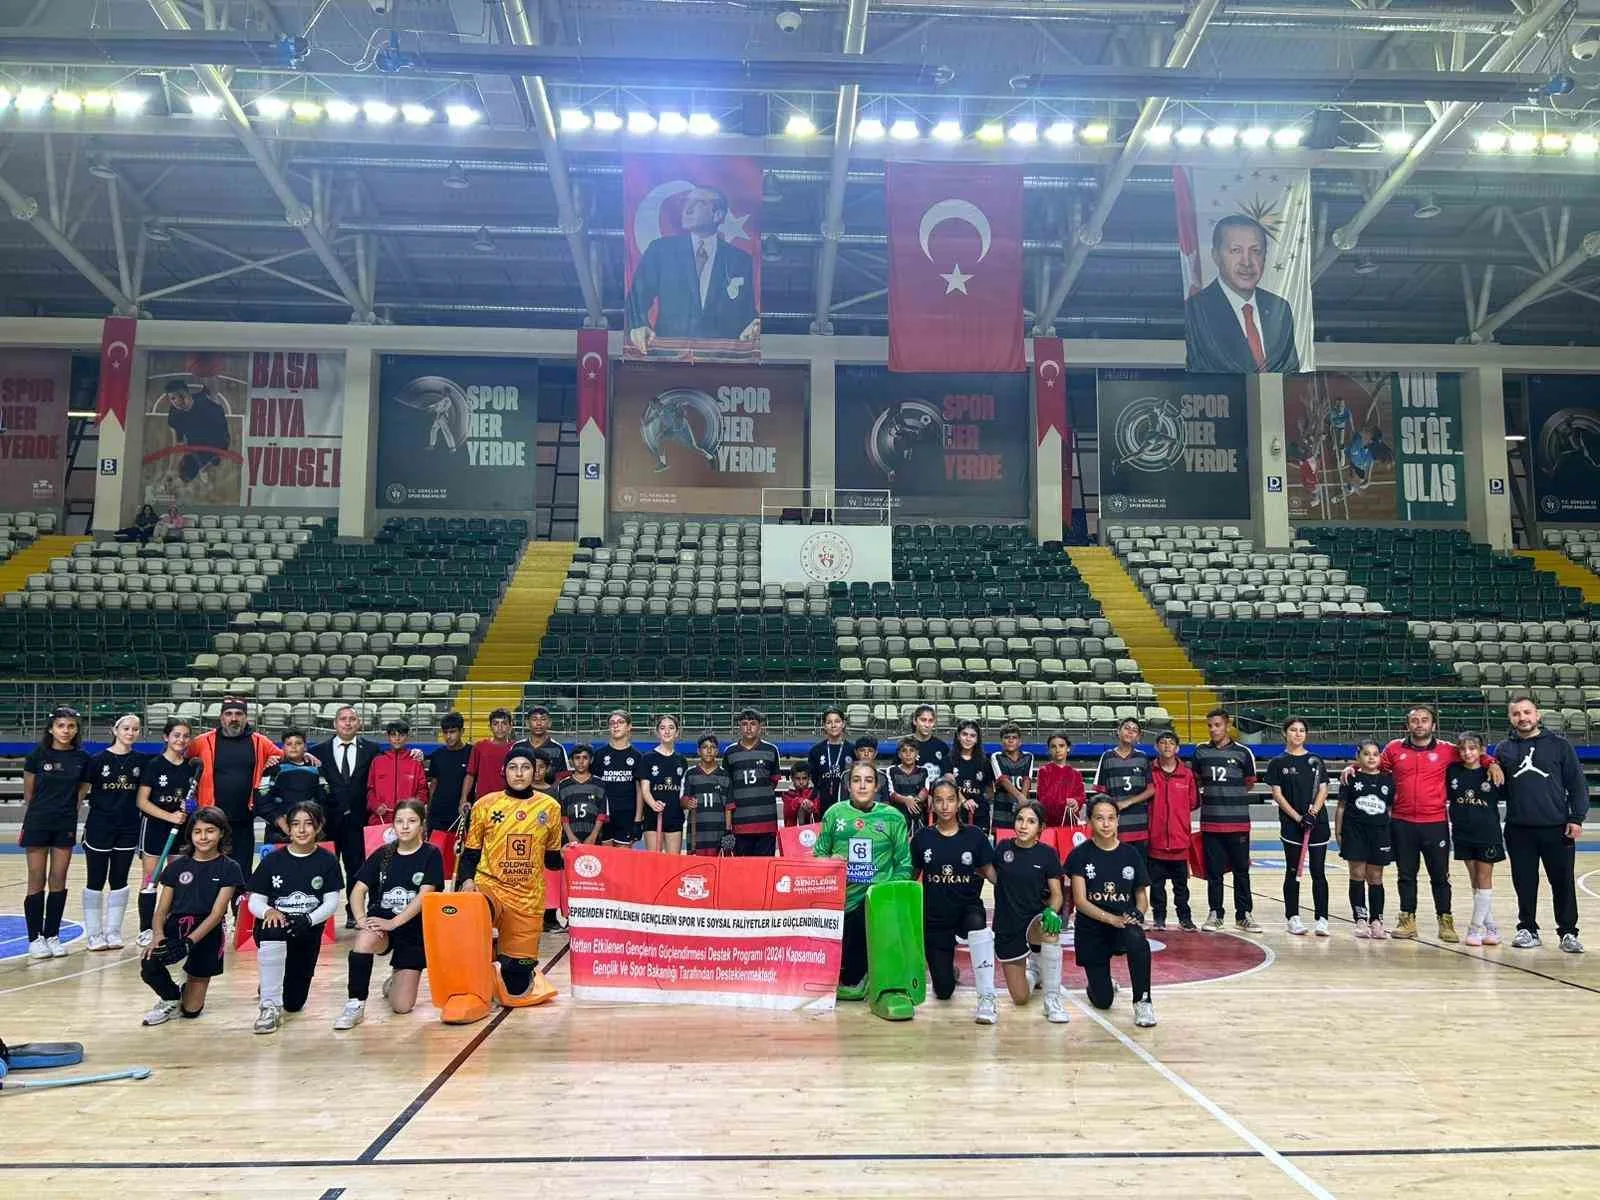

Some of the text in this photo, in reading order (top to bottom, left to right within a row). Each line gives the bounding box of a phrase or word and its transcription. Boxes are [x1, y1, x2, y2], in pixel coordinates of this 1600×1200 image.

[252, 352, 319, 393] BAŞA
[2, 379, 54, 402] SPOR
[467, 385, 519, 411] SPOR
[717, 385, 771, 413] SPOR
[249, 398, 305, 437] RIYA
[943, 395, 995, 420] SPOR
[1181, 394, 1231, 418] SPOR
[468, 413, 503, 438] HER
[720, 416, 754, 443] HER
[943, 424, 979, 450] HER
[1184, 421, 1216, 446] HER
[0, 434, 58, 459] YERDE
[467, 441, 526, 466] YERDE
[104, 459, 114, 470] B
[716, 447, 777, 473] YERDE
[944, 454, 1003, 480] YERDE
[1183, 449, 1237, 473] YERDE
[1270, 477, 1281, 487] D
[1403, 463, 1457, 507] ULAŞ
[1491, 479, 1502, 490] D
[743, 770, 757, 784] 13
[1011, 776, 1023, 790] 10
[1122, 777, 1132, 791] 3
[1211, 767, 1227, 782] 12
[574, 804, 587, 819] 15
[703, 793, 714, 807] 11
[1457, 797, 1488, 807] OYKAN
[928, 874, 970, 884] SOYKAN
[569, 906, 604, 919] EPREMDEN
[605, 907, 640, 923] ETKİLENEN
[641, 912, 677, 928] GENÇLERİN
[678, 916, 696, 928] SPOR
[697, 917, 705, 928] VE
[707, 917, 731, 929] SOYSAL
[732, 917, 770, 929] FALİYETLER
[708, 947, 731, 961] Destek
[764, 947, 784, 964] (2024)
[620, 962, 629, 974] Ve
[629, 961, 646, 977] Spor
